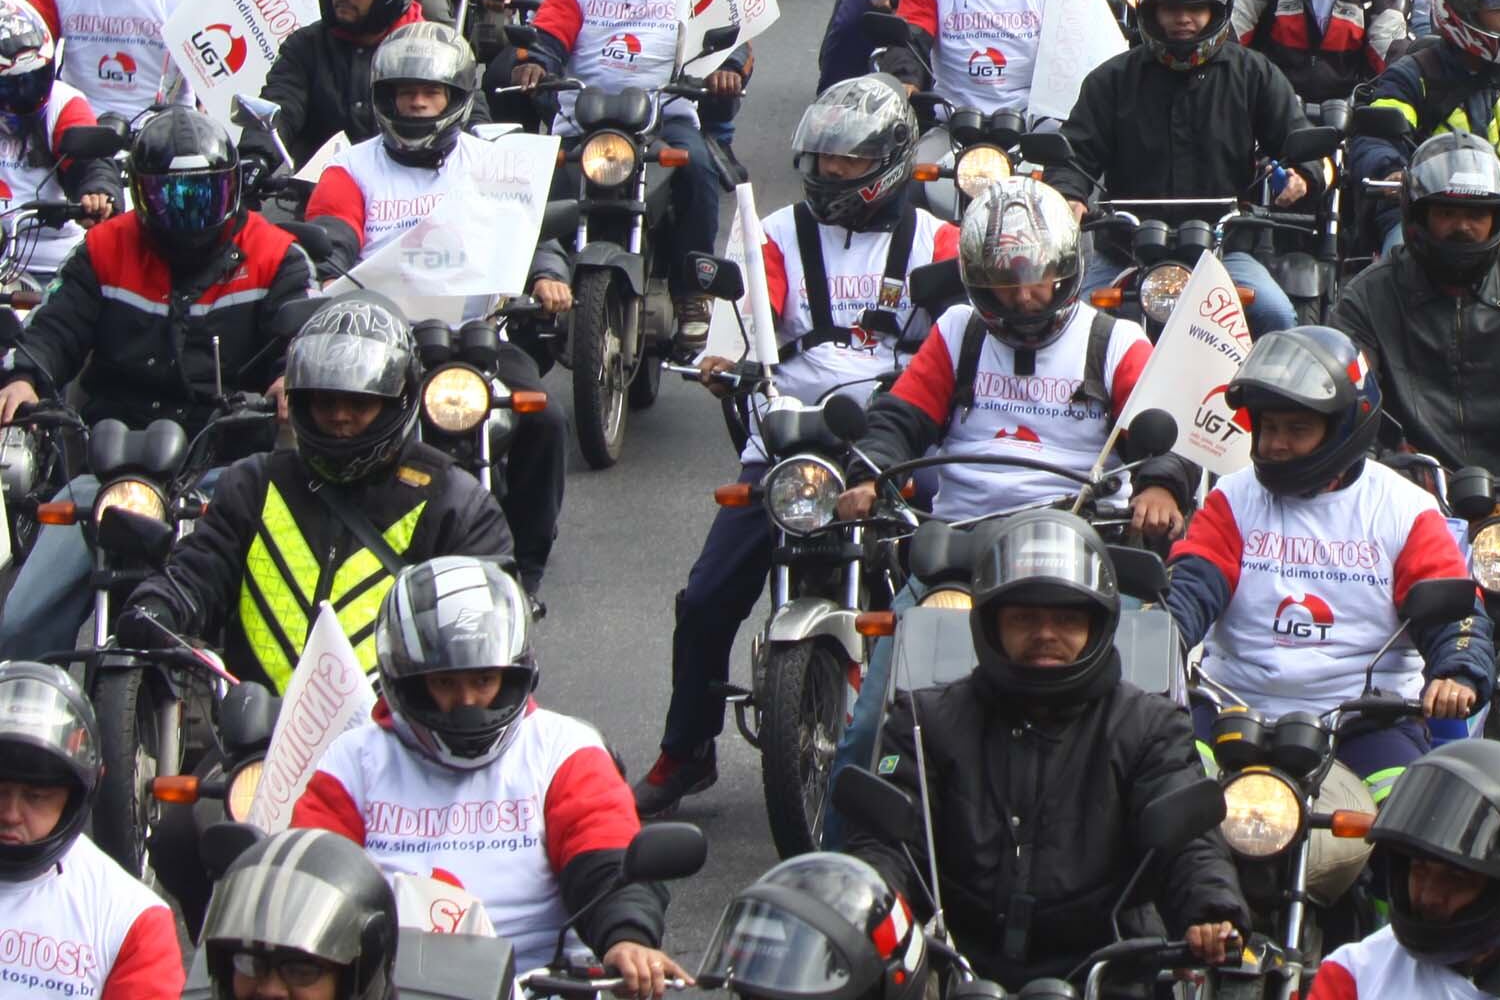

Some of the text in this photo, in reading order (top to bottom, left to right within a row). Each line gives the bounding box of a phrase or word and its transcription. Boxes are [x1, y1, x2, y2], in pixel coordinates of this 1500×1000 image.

[66, 14, 164, 37] SINDIMOTOS
[191, 29, 229, 82] UGT
[602, 47, 636, 63] UGT
[98, 67, 135, 82] UGT
[969, 64, 1003, 77] UGT
[1195, 405, 1243, 444] UGT
[1273, 619, 1331, 641] UGT
